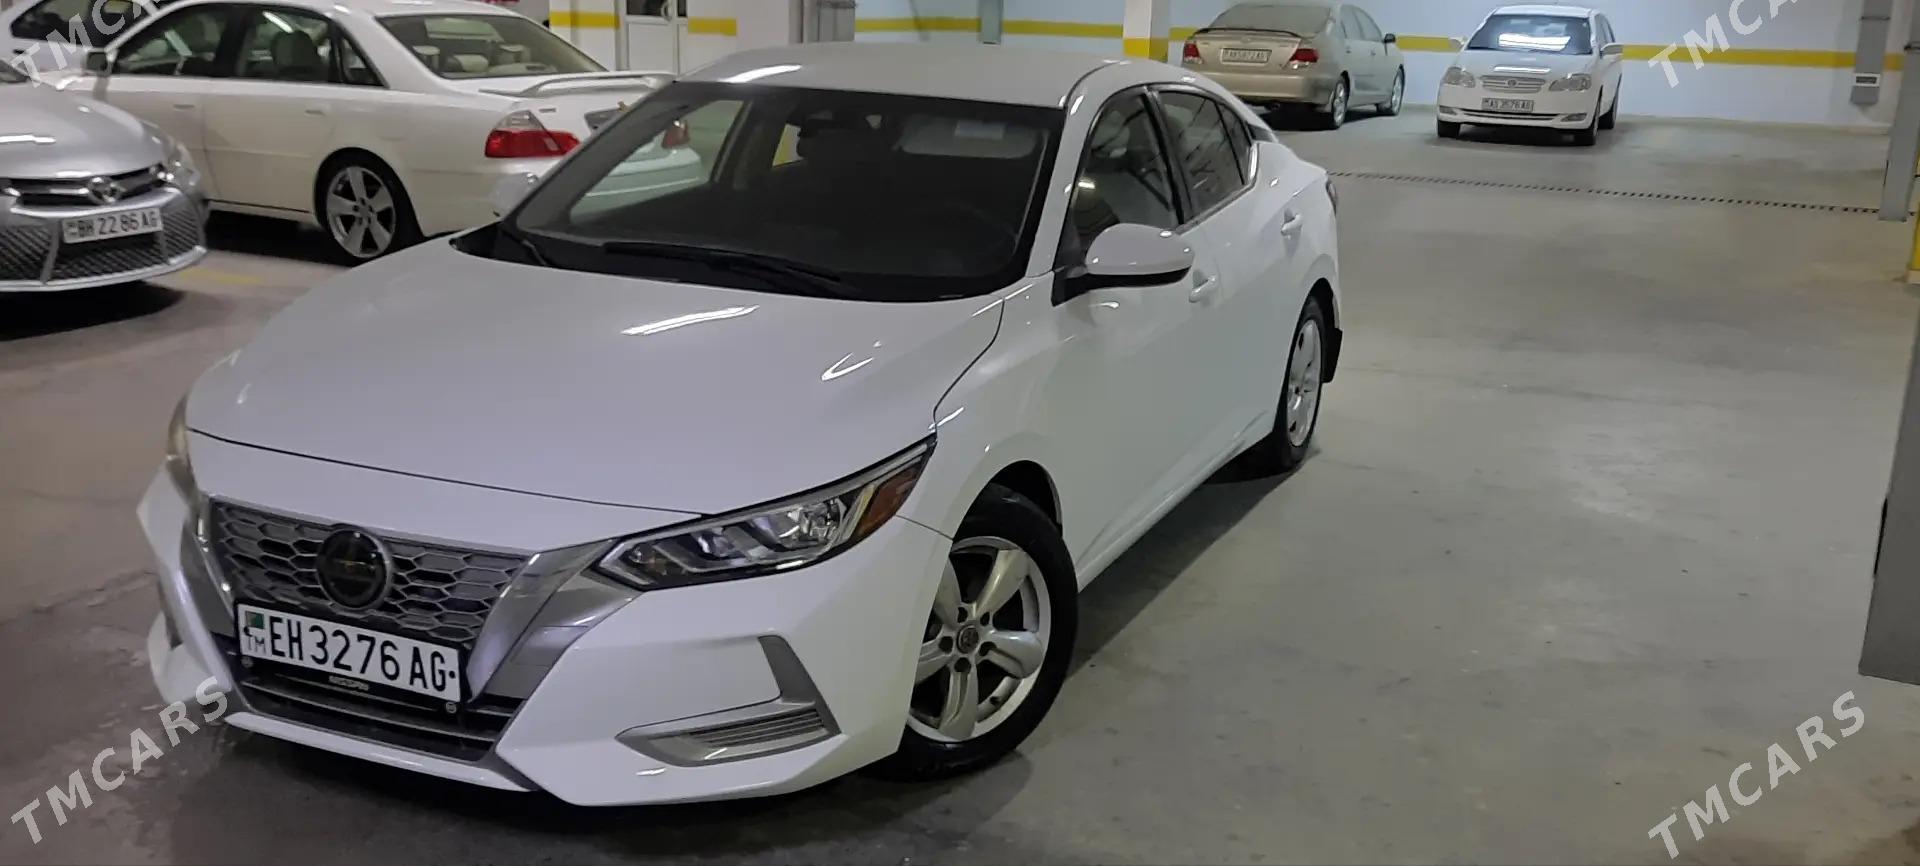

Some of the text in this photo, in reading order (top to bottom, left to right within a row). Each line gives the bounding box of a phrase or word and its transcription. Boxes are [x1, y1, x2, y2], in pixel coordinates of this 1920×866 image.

[269, 615, 446, 692] EH 3276 AG
